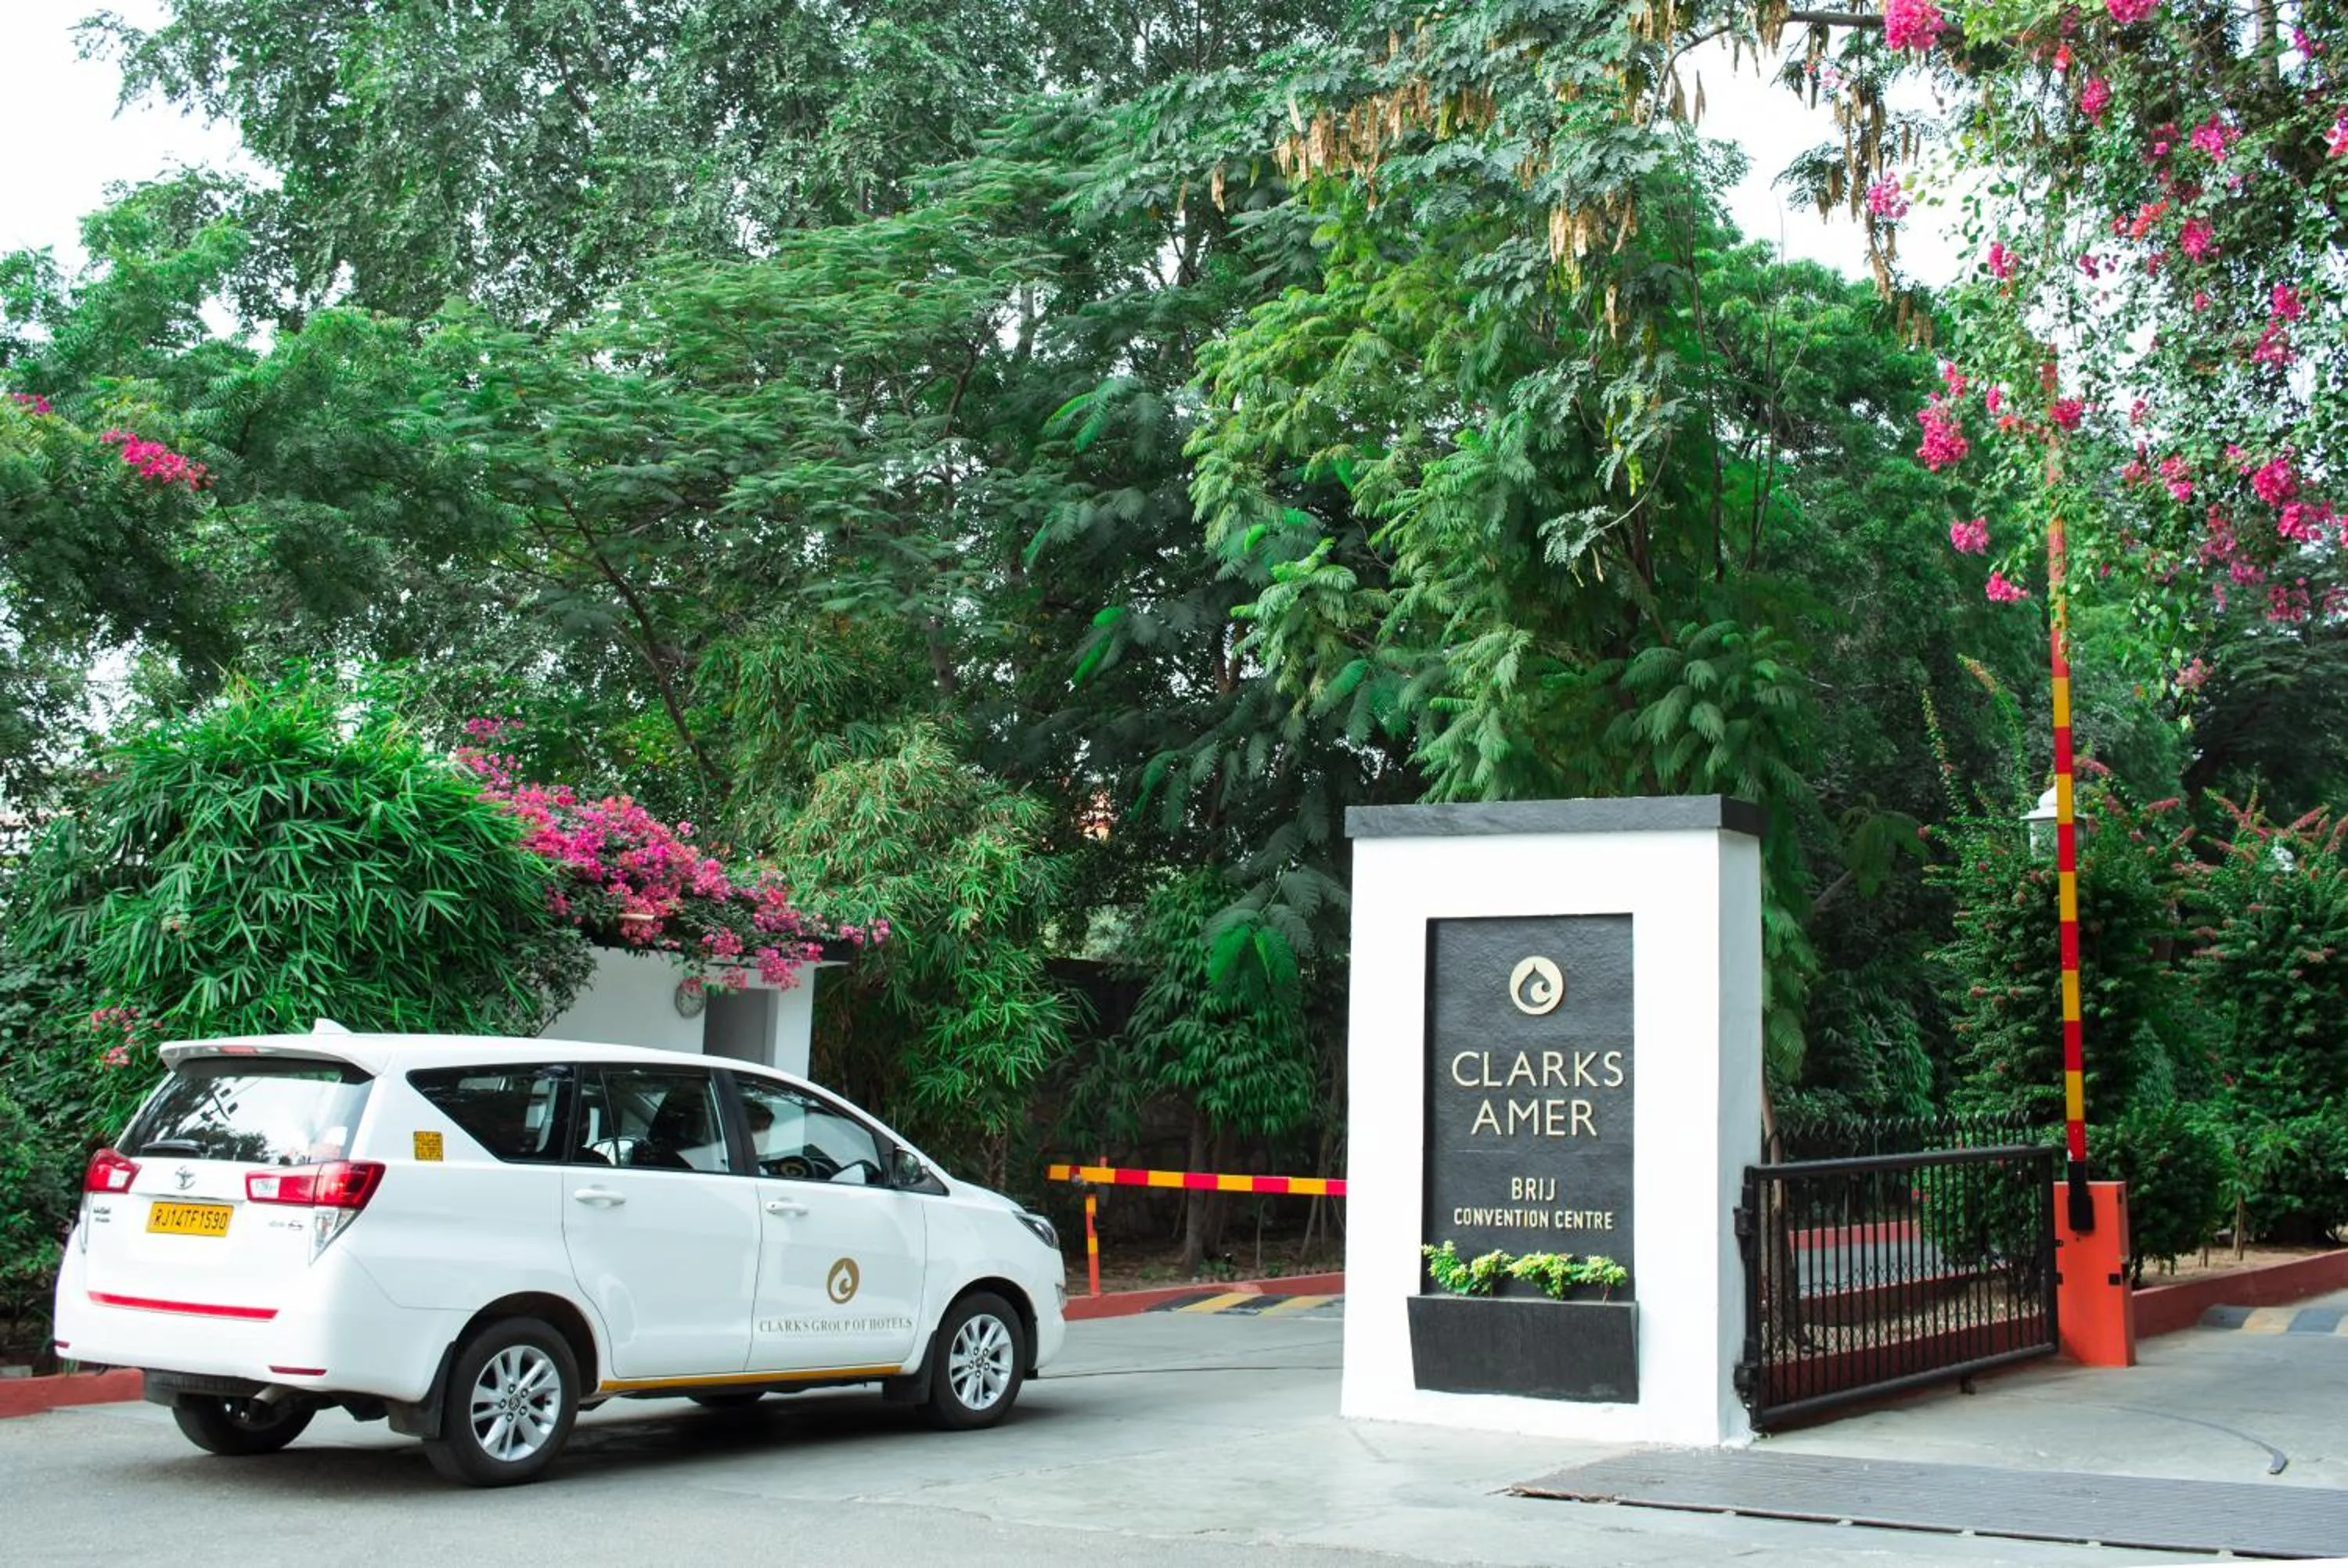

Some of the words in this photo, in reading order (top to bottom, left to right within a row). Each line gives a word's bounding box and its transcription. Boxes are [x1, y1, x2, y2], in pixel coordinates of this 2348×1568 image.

[1452, 1051, 1624, 1087] CLARKS
[1471, 1099, 1597, 1136] AMER
[1511, 1178, 1557, 1200] BRIJ
[155, 1208, 228, 1229] RJ14TF1590
[1453, 1207, 1550, 1228] CONVENTION
[1555, 1210, 1614, 1229] CENTRE
[759, 1319, 809, 1332] CLARKS
[812, 1319, 852, 1332] GROUP
[853, 1319, 867, 1331] OF
[870, 1317, 913, 1330] HOTELS
